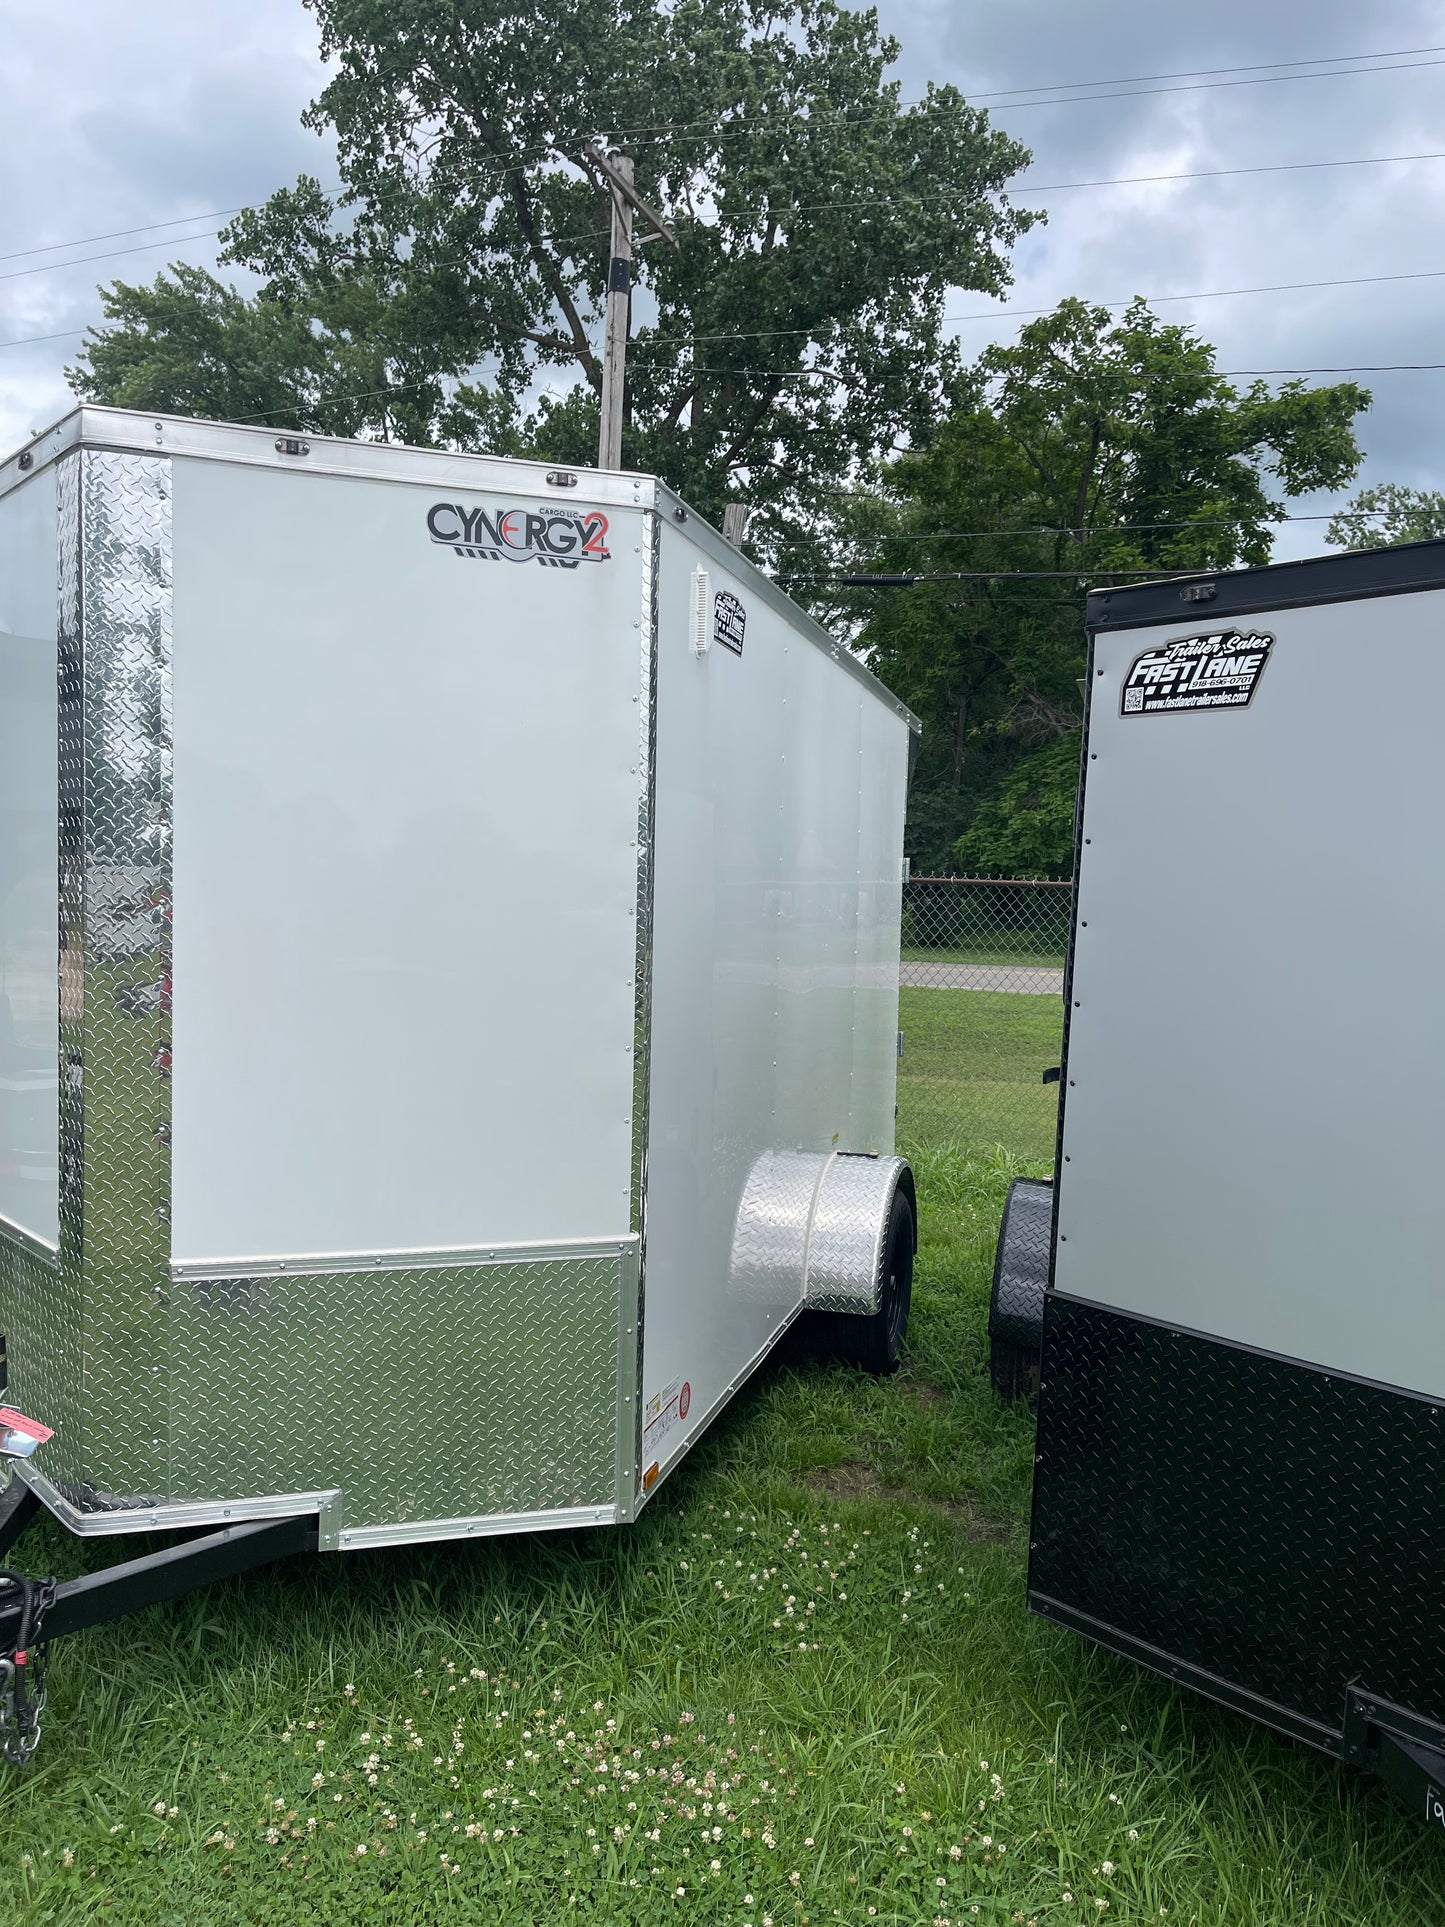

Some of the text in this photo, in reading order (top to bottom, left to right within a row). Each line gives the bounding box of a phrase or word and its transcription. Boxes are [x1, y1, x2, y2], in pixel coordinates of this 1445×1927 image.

[539, 507, 579, 519] CARGO LLC
[1168, 635, 1271, 661] Trailer Sales
[1128, 654, 1263, 686] FAST LANE
[1191, 676, 1252, 688] 918-696-0701
[1144, 691, 1249, 710] www.fastlanetrailersales.com
